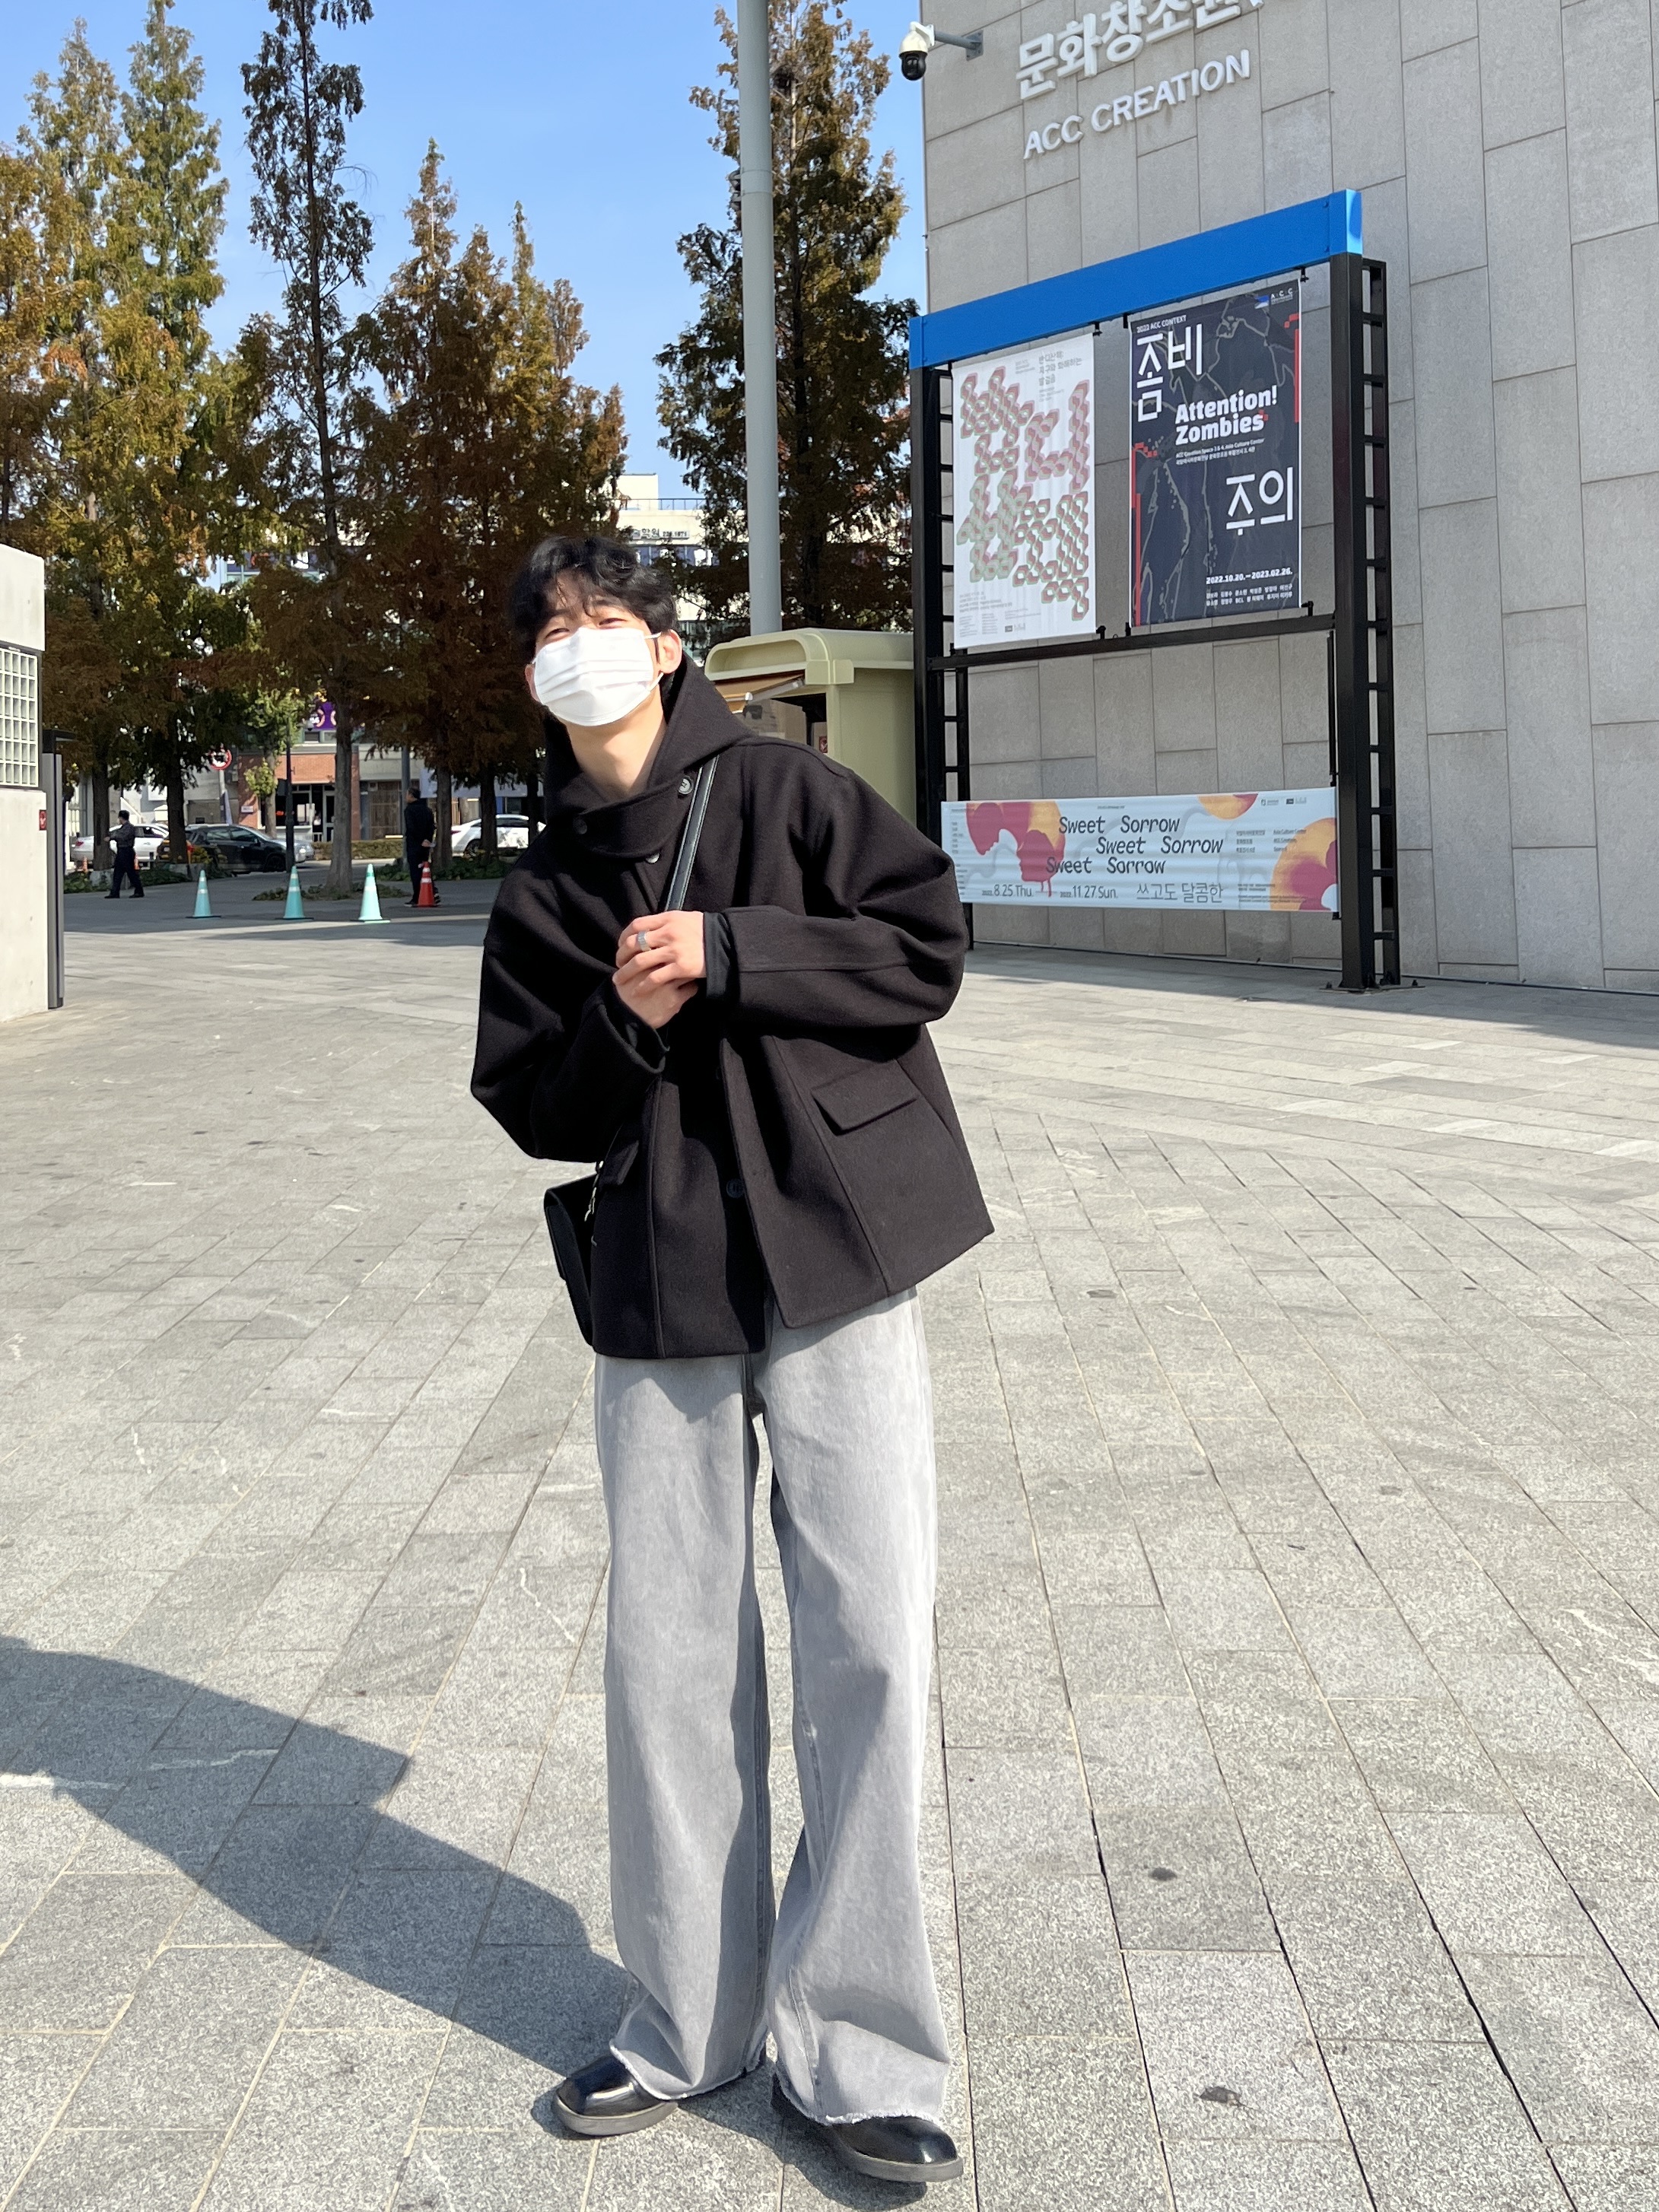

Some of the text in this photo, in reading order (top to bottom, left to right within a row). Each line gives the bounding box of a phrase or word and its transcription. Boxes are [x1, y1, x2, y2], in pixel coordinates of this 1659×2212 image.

[1023, 49, 1250, 160] ACC CREATION
[1136, 323, 1202, 422] 좀비
[1175, 384, 1277, 424] Attention!
[1175, 412, 1264, 446] Zombies
[1226, 466, 1293, 536] 주의
[1058, 815, 1180, 834] Sweet Sorrow
[1095, 836, 1223, 854] Sweet Sorrow
[1045, 857, 1166, 874] Sweet Sorrow
[1136, 882, 1178, 901] 쓰고도
[1181, 882, 1224, 904] 달콤한
